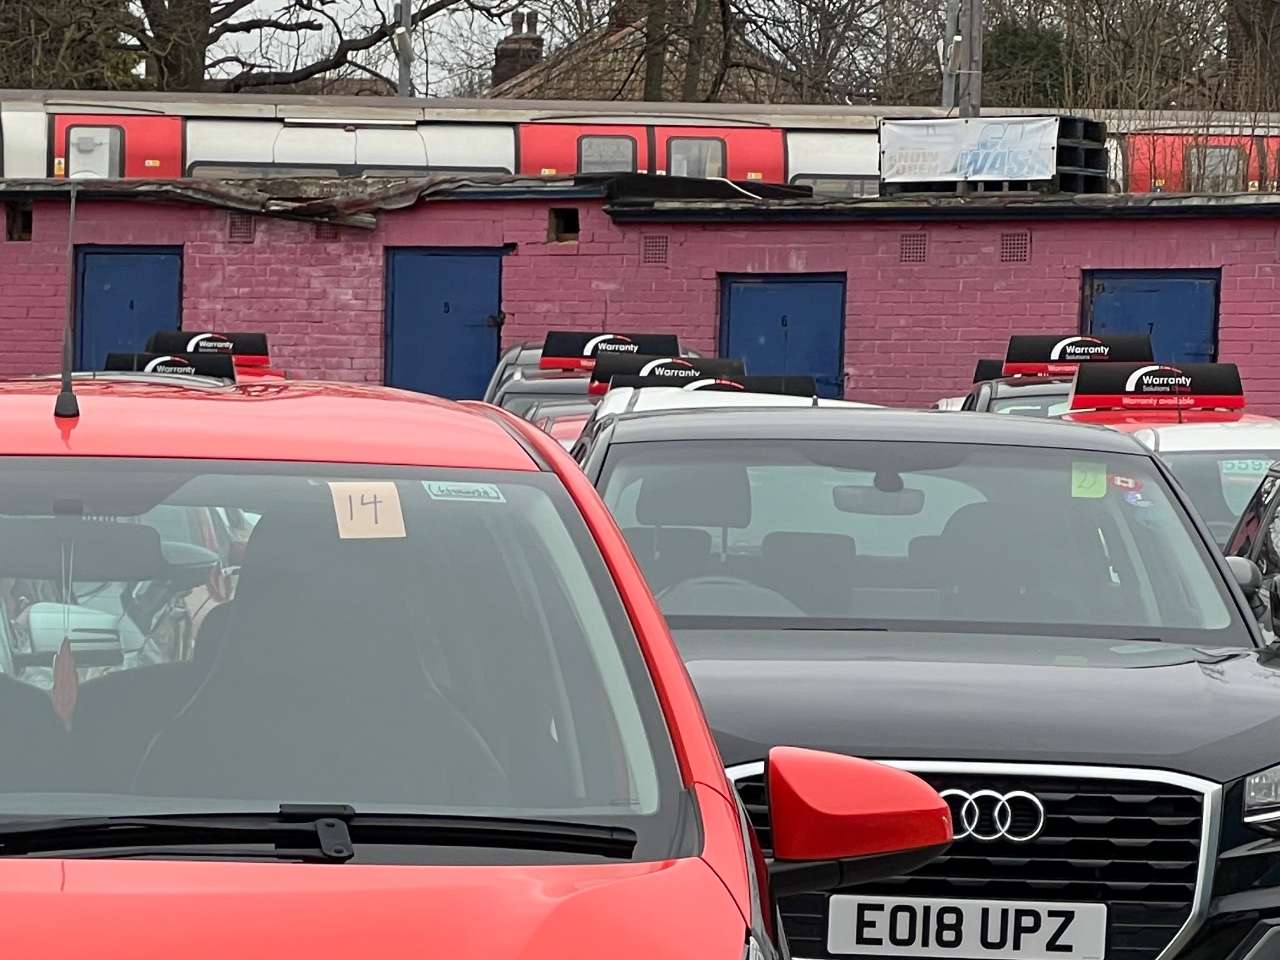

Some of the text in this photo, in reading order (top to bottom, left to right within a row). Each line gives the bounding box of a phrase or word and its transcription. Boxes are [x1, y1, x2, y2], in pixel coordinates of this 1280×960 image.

[443, 301, 450, 314] 5
[781, 314, 788, 328] 6
[1146, 322, 1154, 335] 7
[198, 340, 234, 350] Warranty
[597, 342, 639, 353] Warranty
[1065, 345, 1110, 356] Warranty
[156, 364, 196, 375] Warranty
[654, 366, 701, 377] Warranty
[1142, 375, 1192, 387] Warranty
[1122, 396, 1157, 407] Warranty
[348, 494, 383, 525] 14
[855, 902, 1076, 953] EO18 UPZ
